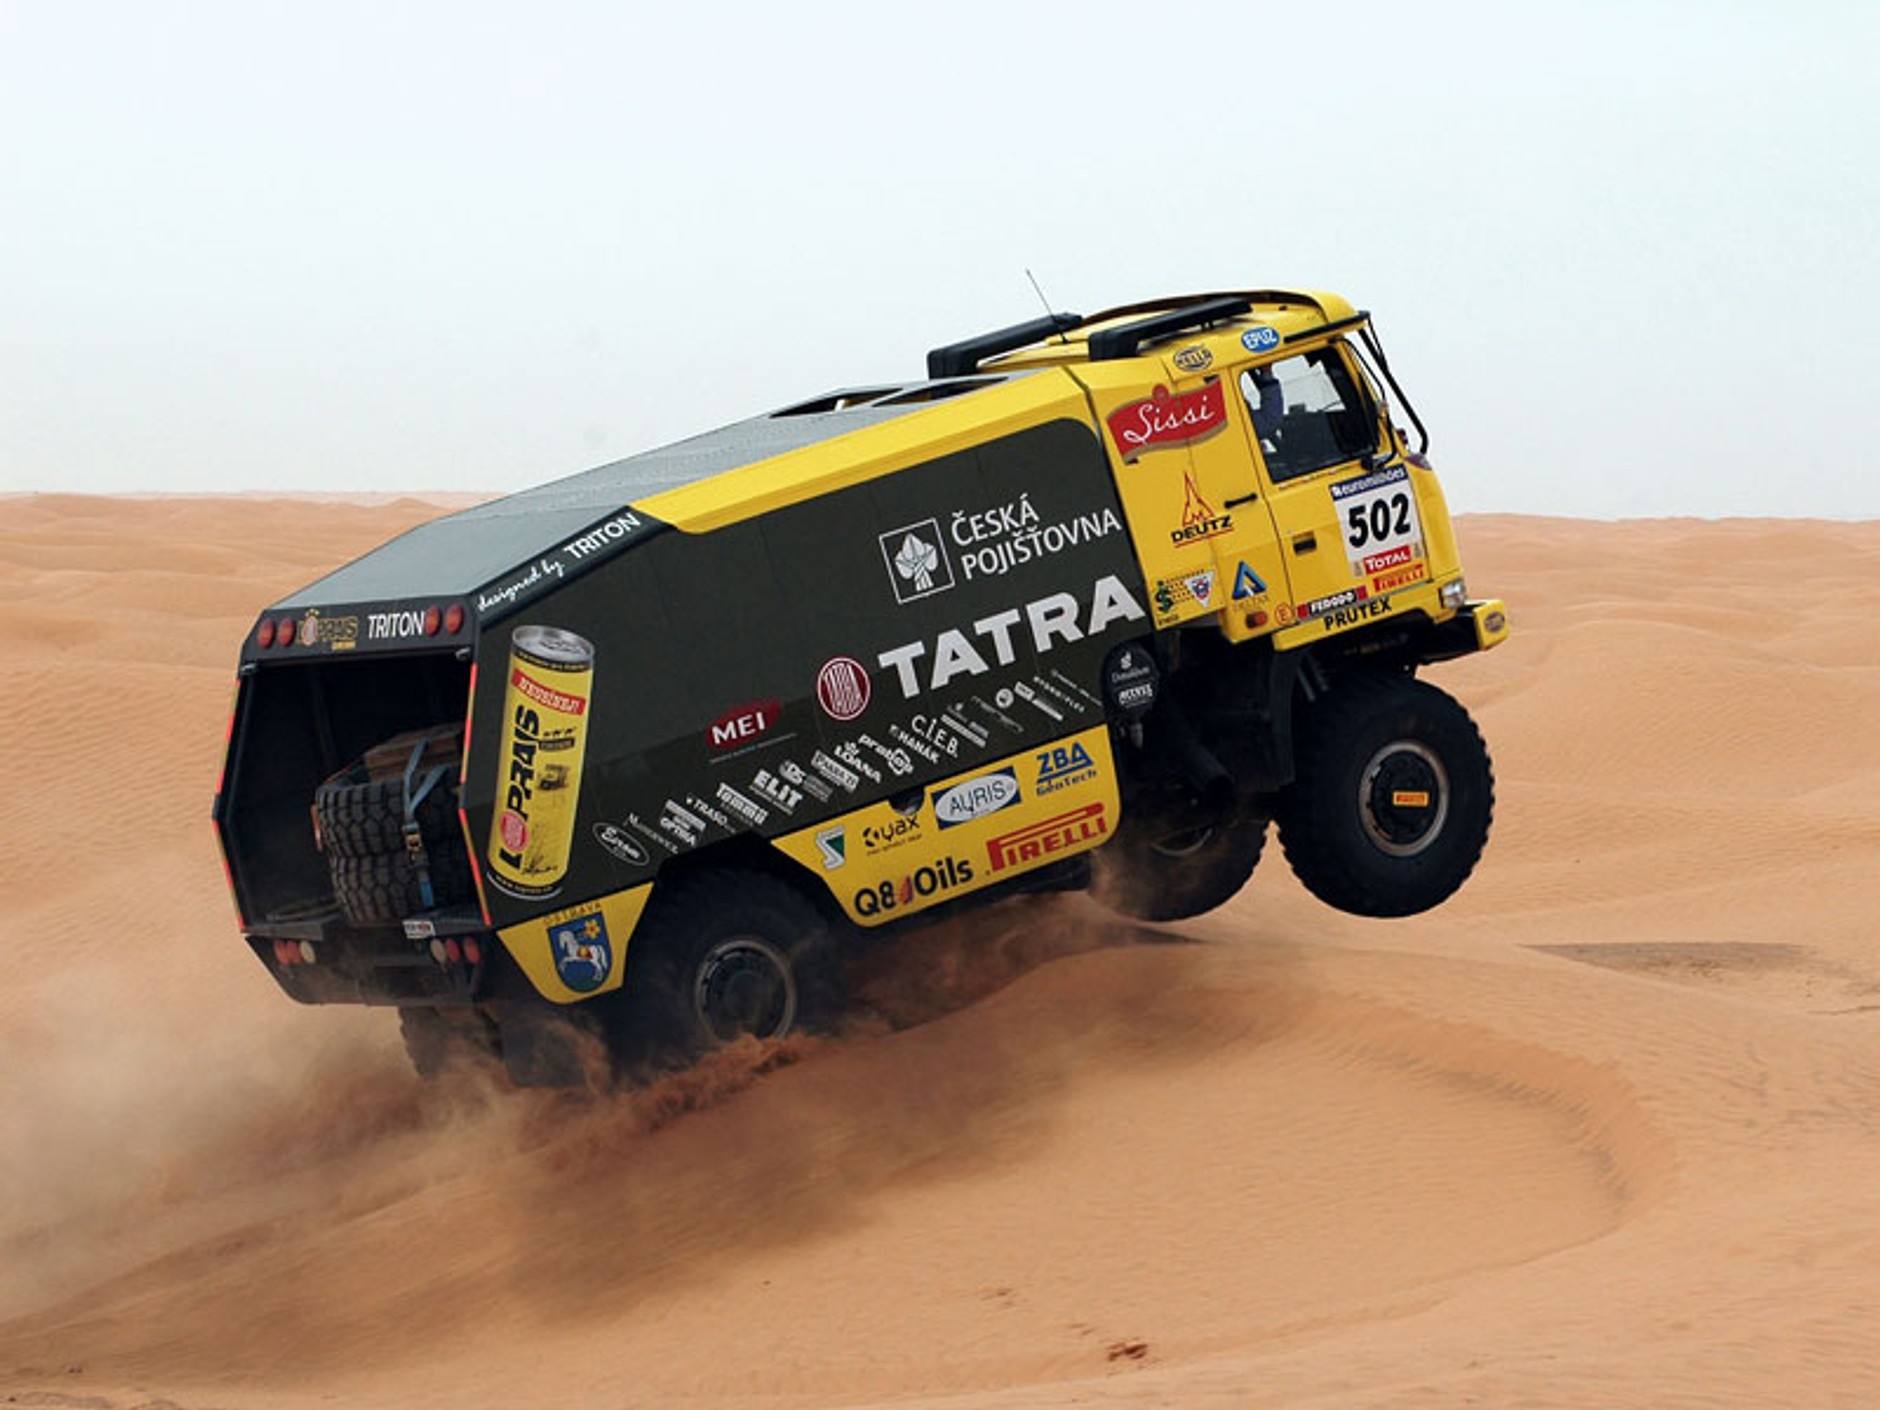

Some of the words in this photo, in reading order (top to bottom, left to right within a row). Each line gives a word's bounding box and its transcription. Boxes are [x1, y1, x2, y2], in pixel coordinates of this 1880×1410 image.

[1123, 396, 1215, 444] Sissi
[951, 493, 1040, 547] ČESKÁ
[1171, 515, 1233, 543] DEUTZ
[1349, 493, 1411, 548] 502
[478, 566, 541, 612] designed
[541, 559, 565, 578] by
[563, 512, 642, 559] TRITON
[961, 508, 1122, 580] POJIŠŤOVNA
[1365, 551, 1410, 571] TOTAL
[367, 611, 425, 639] TRITON
[878, 574, 1146, 699] TATRA
[1324, 598, 1393, 631] PRUTEX
[711, 711, 766, 745] MEI
[1036, 742, 1094, 776] ZBA
[753, 768, 803, 809] ELIT
[950, 780, 1007, 816] AURIS
[985, 802, 1107, 872] PIRELLI
[854, 881, 895, 917] Q8
[913, 857, 974, 896] Oils
